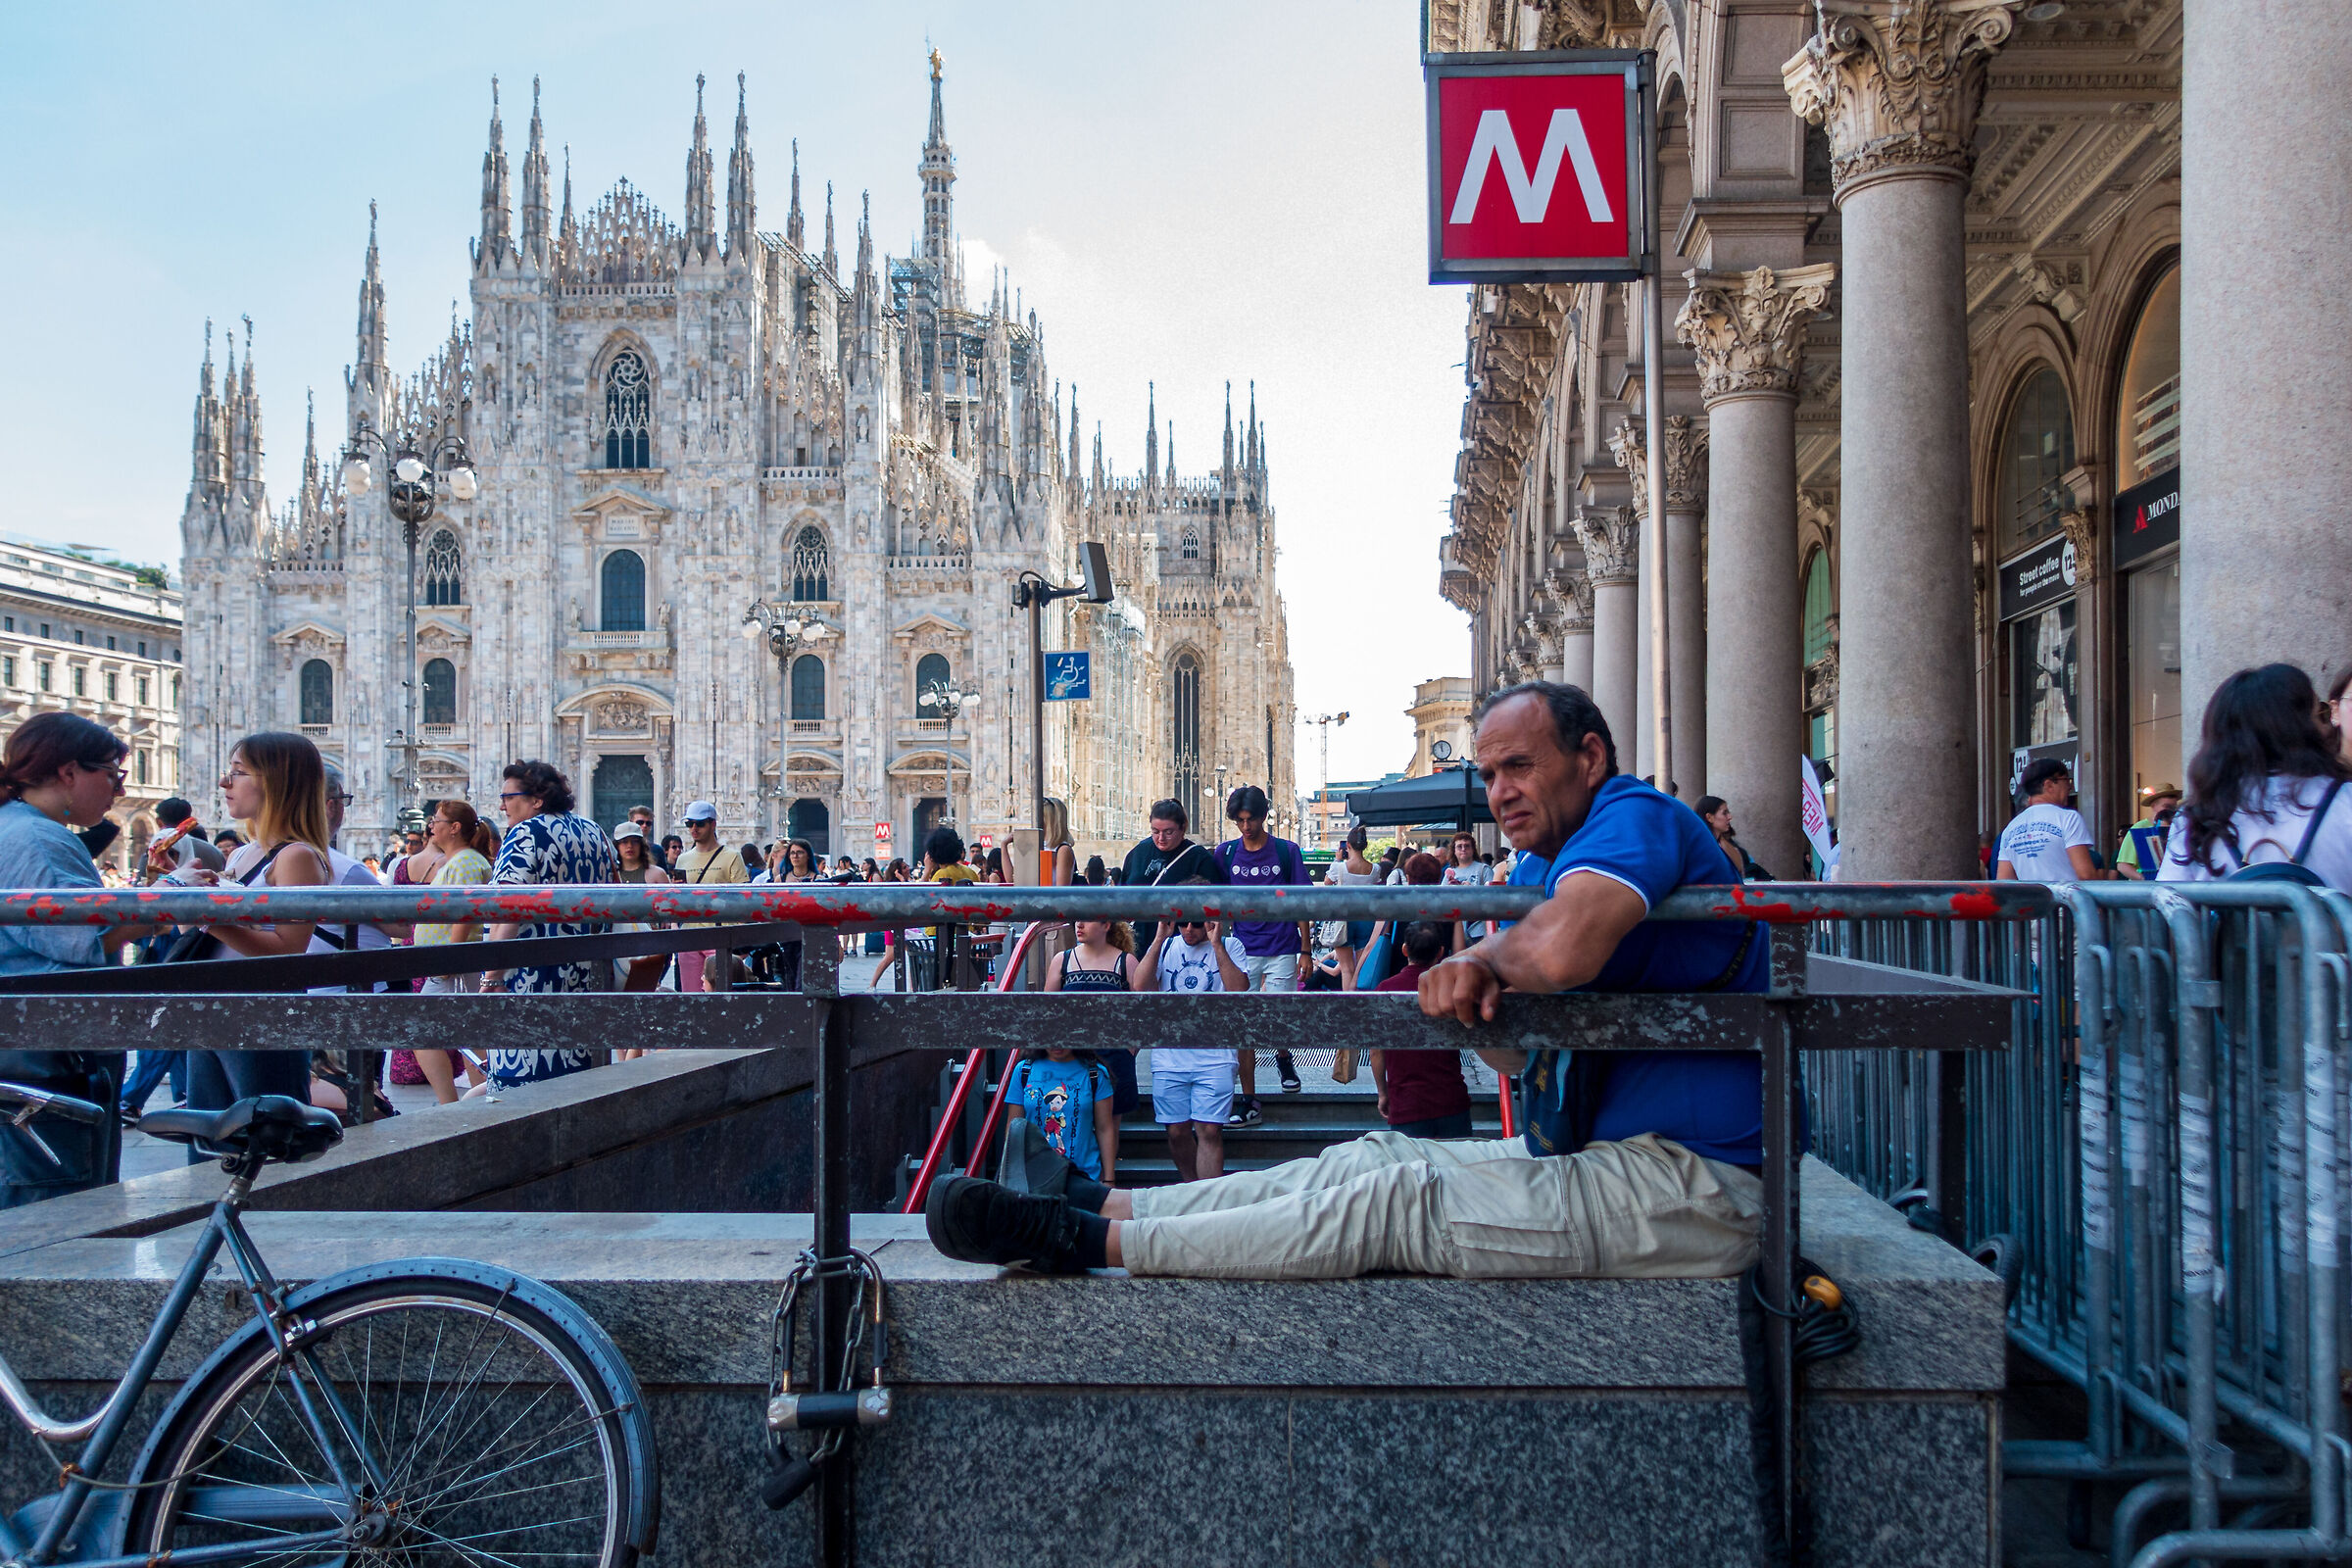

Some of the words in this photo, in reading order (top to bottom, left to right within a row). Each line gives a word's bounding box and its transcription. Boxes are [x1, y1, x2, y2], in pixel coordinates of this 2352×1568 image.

[1448, 108, 1614, 224] M
[2147, 491, 2180, 521] MOND
[2019, 565, 2038, 586] Street
[2038, 557, 2060, 576] coffee
